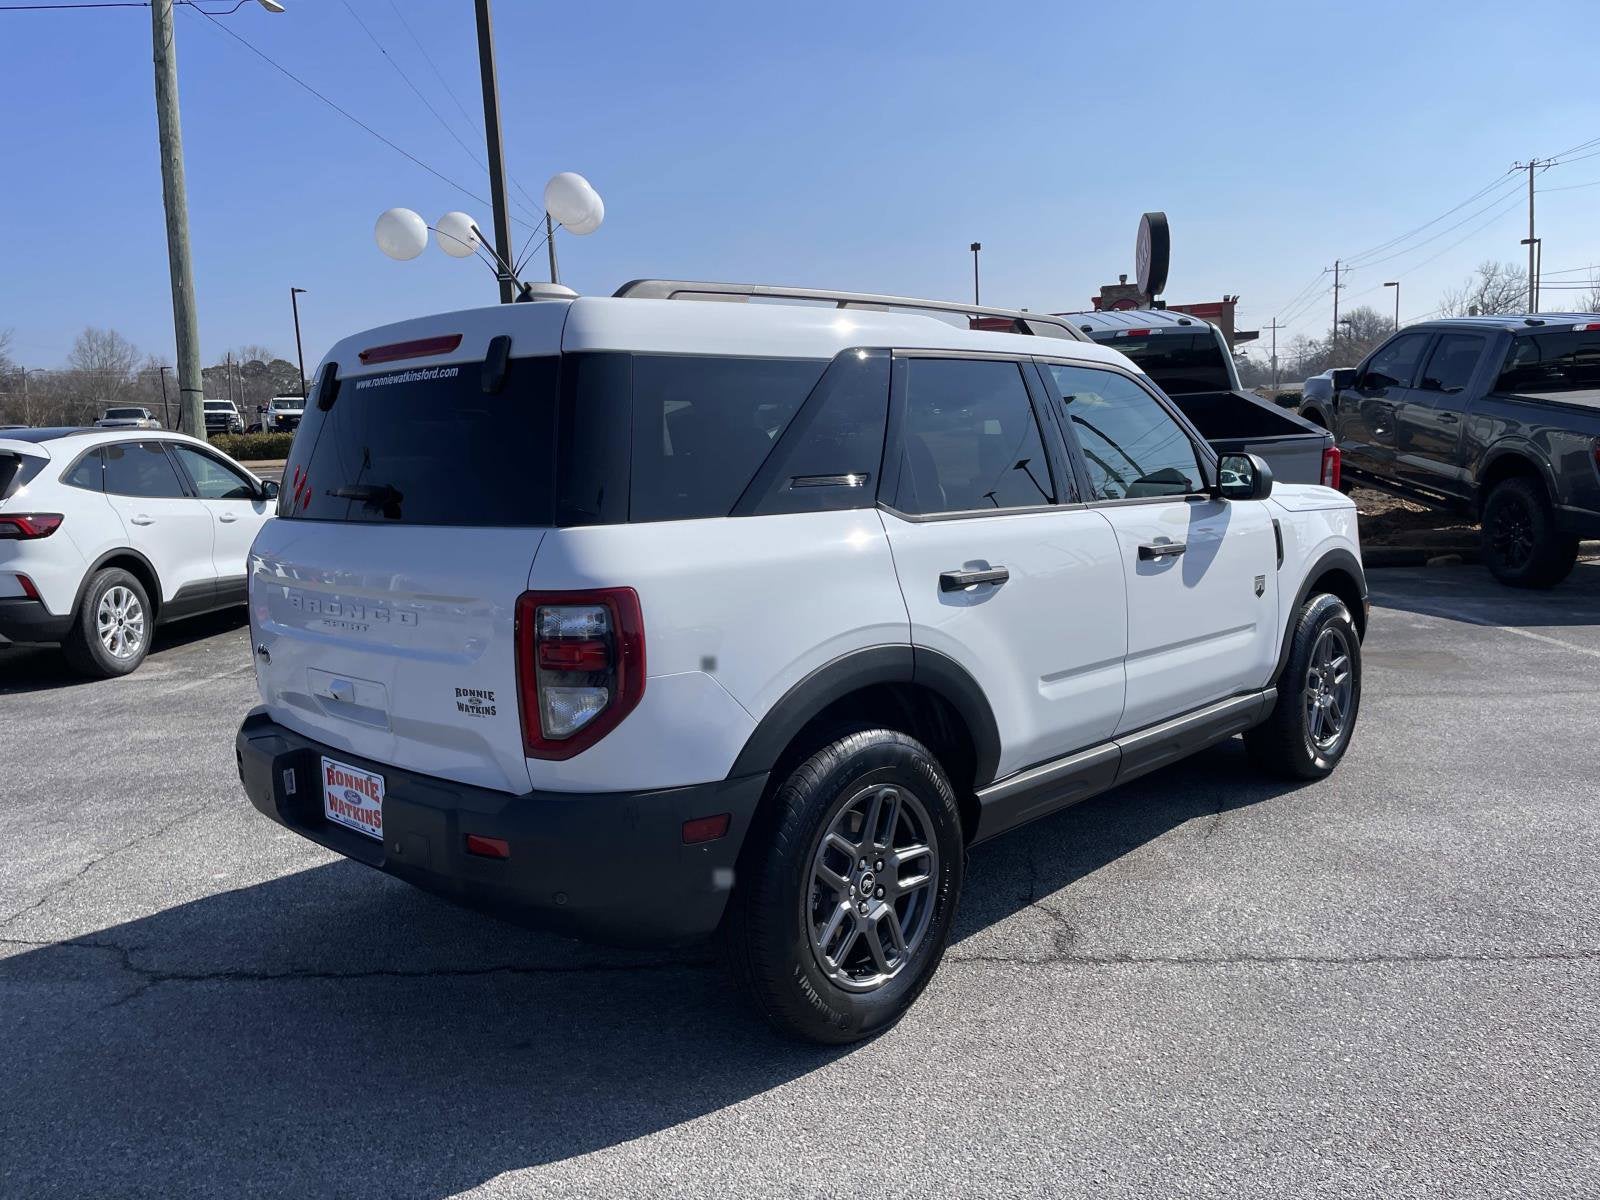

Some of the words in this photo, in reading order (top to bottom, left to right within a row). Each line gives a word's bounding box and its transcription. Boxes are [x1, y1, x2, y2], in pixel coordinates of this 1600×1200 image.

[356, 366, 459, 390] www.ronniewatkinsford.com
[290, 594, 419, 629] BRONCO
[454, 687, 495, 702] RONNIE
[456, 701, 497, 716] WATKINS
[326, 767, 380, 803] RONNIE
[327, 791, 382, 829] WATKINS
